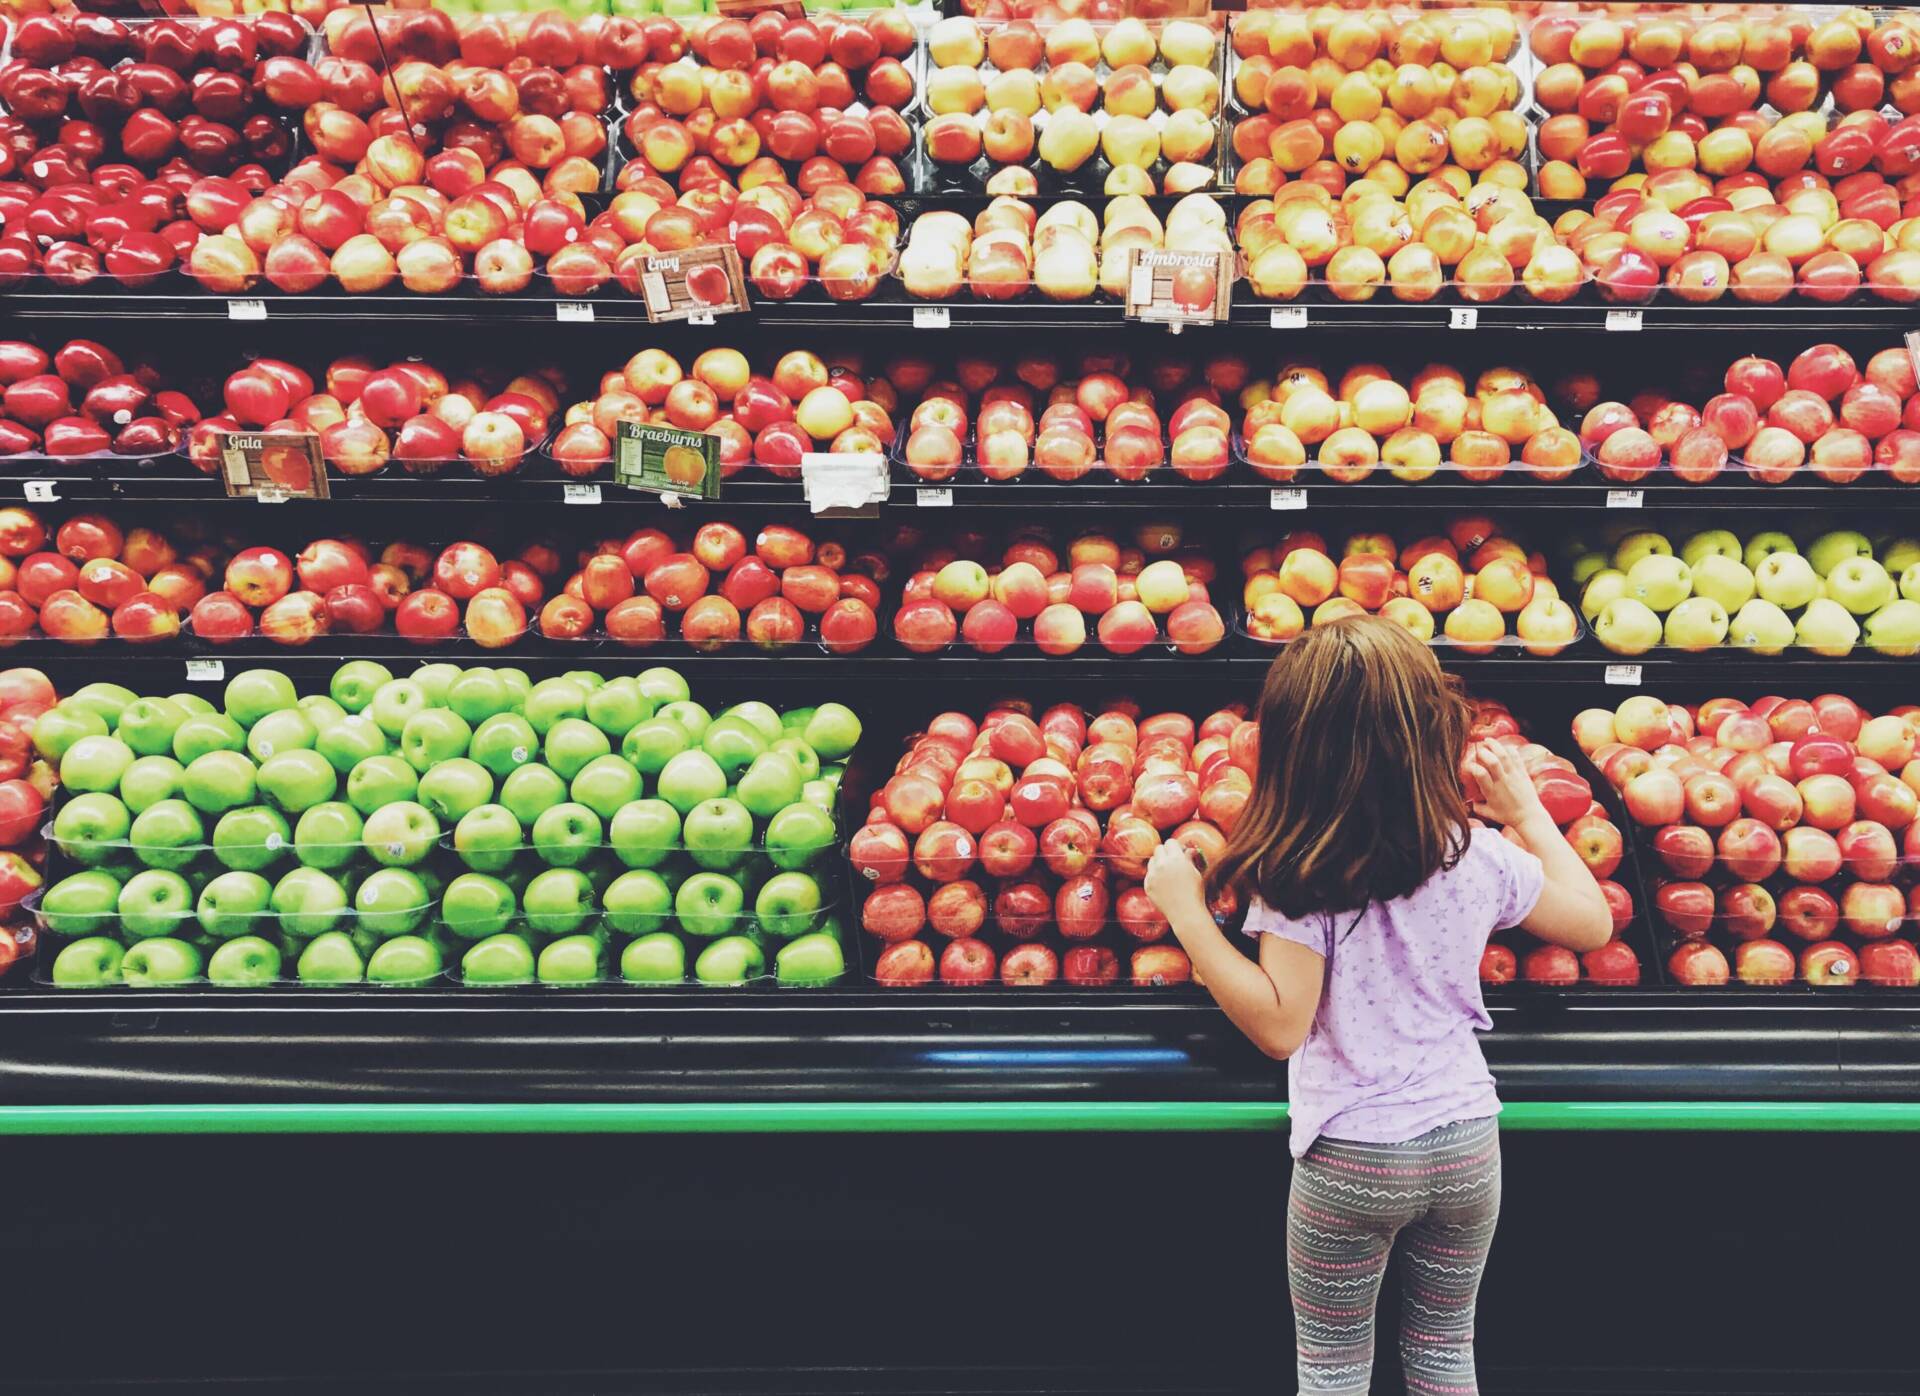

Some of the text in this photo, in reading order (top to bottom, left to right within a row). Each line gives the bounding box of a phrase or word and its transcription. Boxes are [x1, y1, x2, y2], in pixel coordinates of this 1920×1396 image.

[647, 255, 680, 272] Envy
[1141, 250, 1218, 267] Ambrosia
[228, 434, 263, 450] Gala
[629, 424, 702, 447] Braeburns
